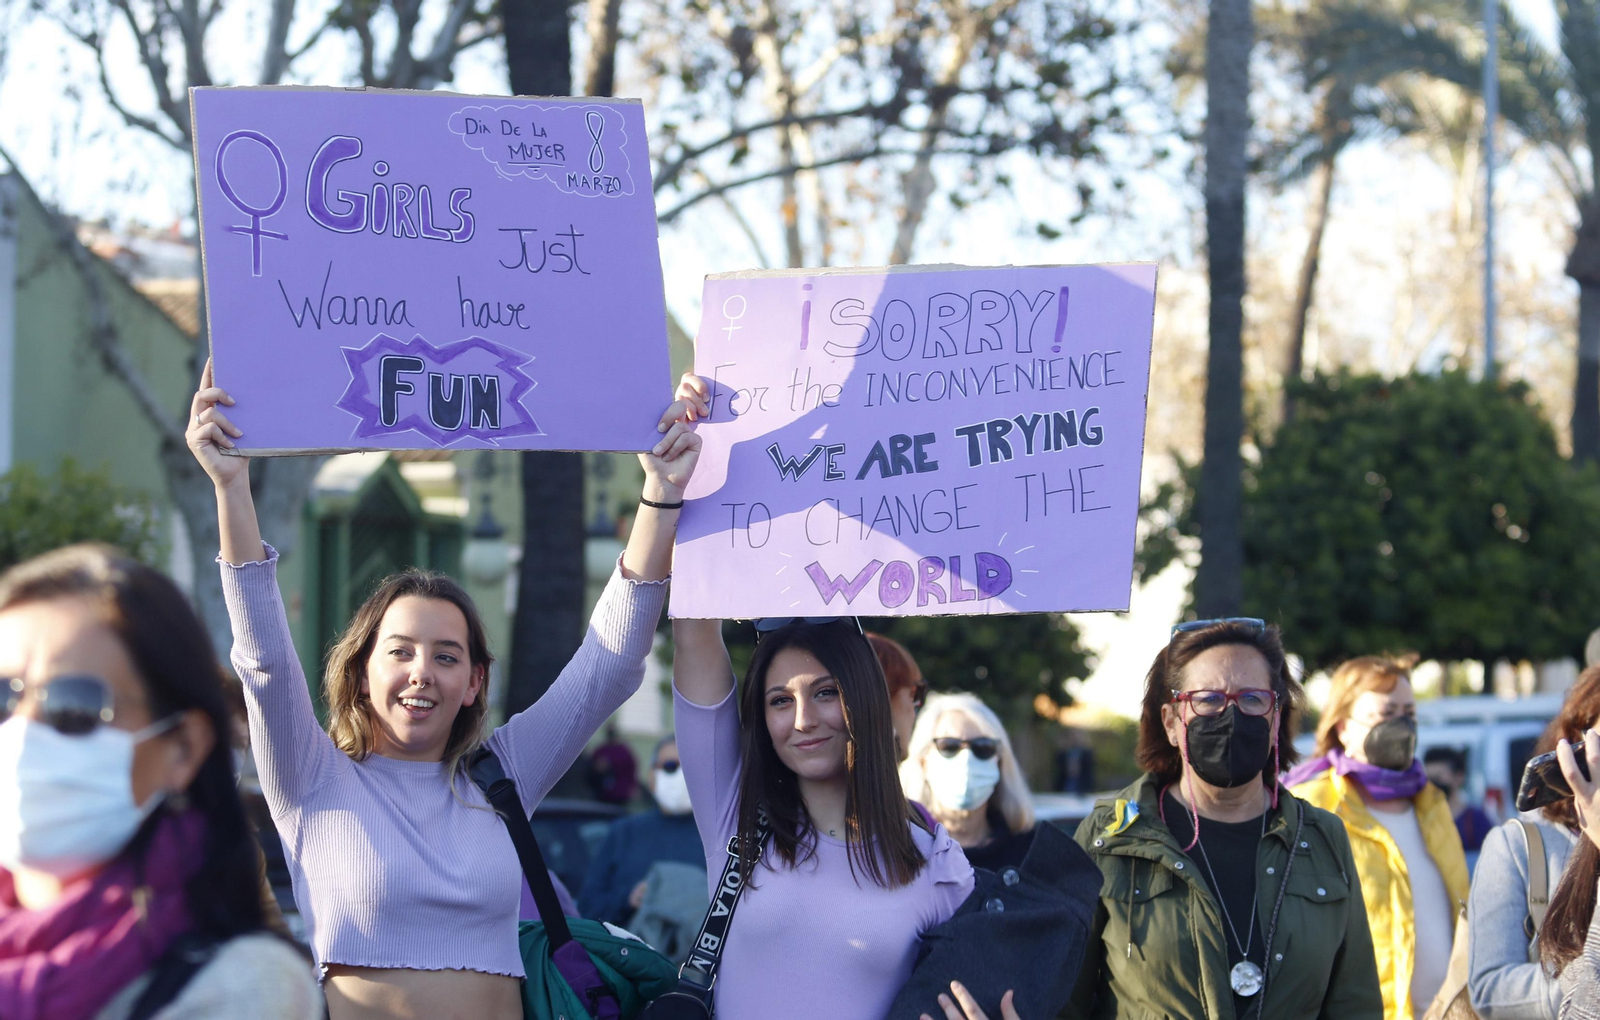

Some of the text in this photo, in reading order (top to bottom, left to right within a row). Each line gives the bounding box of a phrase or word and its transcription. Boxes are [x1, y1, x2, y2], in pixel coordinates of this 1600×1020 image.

[508, 142, 565, 161] MUJER
[585, 111, 605, 173] 8
[566, 172, 622, 194] MARZO
[278, 260, 531, 330] Wanna have
[379, 354, 501, 431] FUN
[707, 351, 1126, 421] For the INCONVENIENCE
[767, 406, 1104, 482] WE ARE TRYING
[721, 464, 1112, 549] TO CHANGE THE
[804, 551, 1014, 609] WORLD
